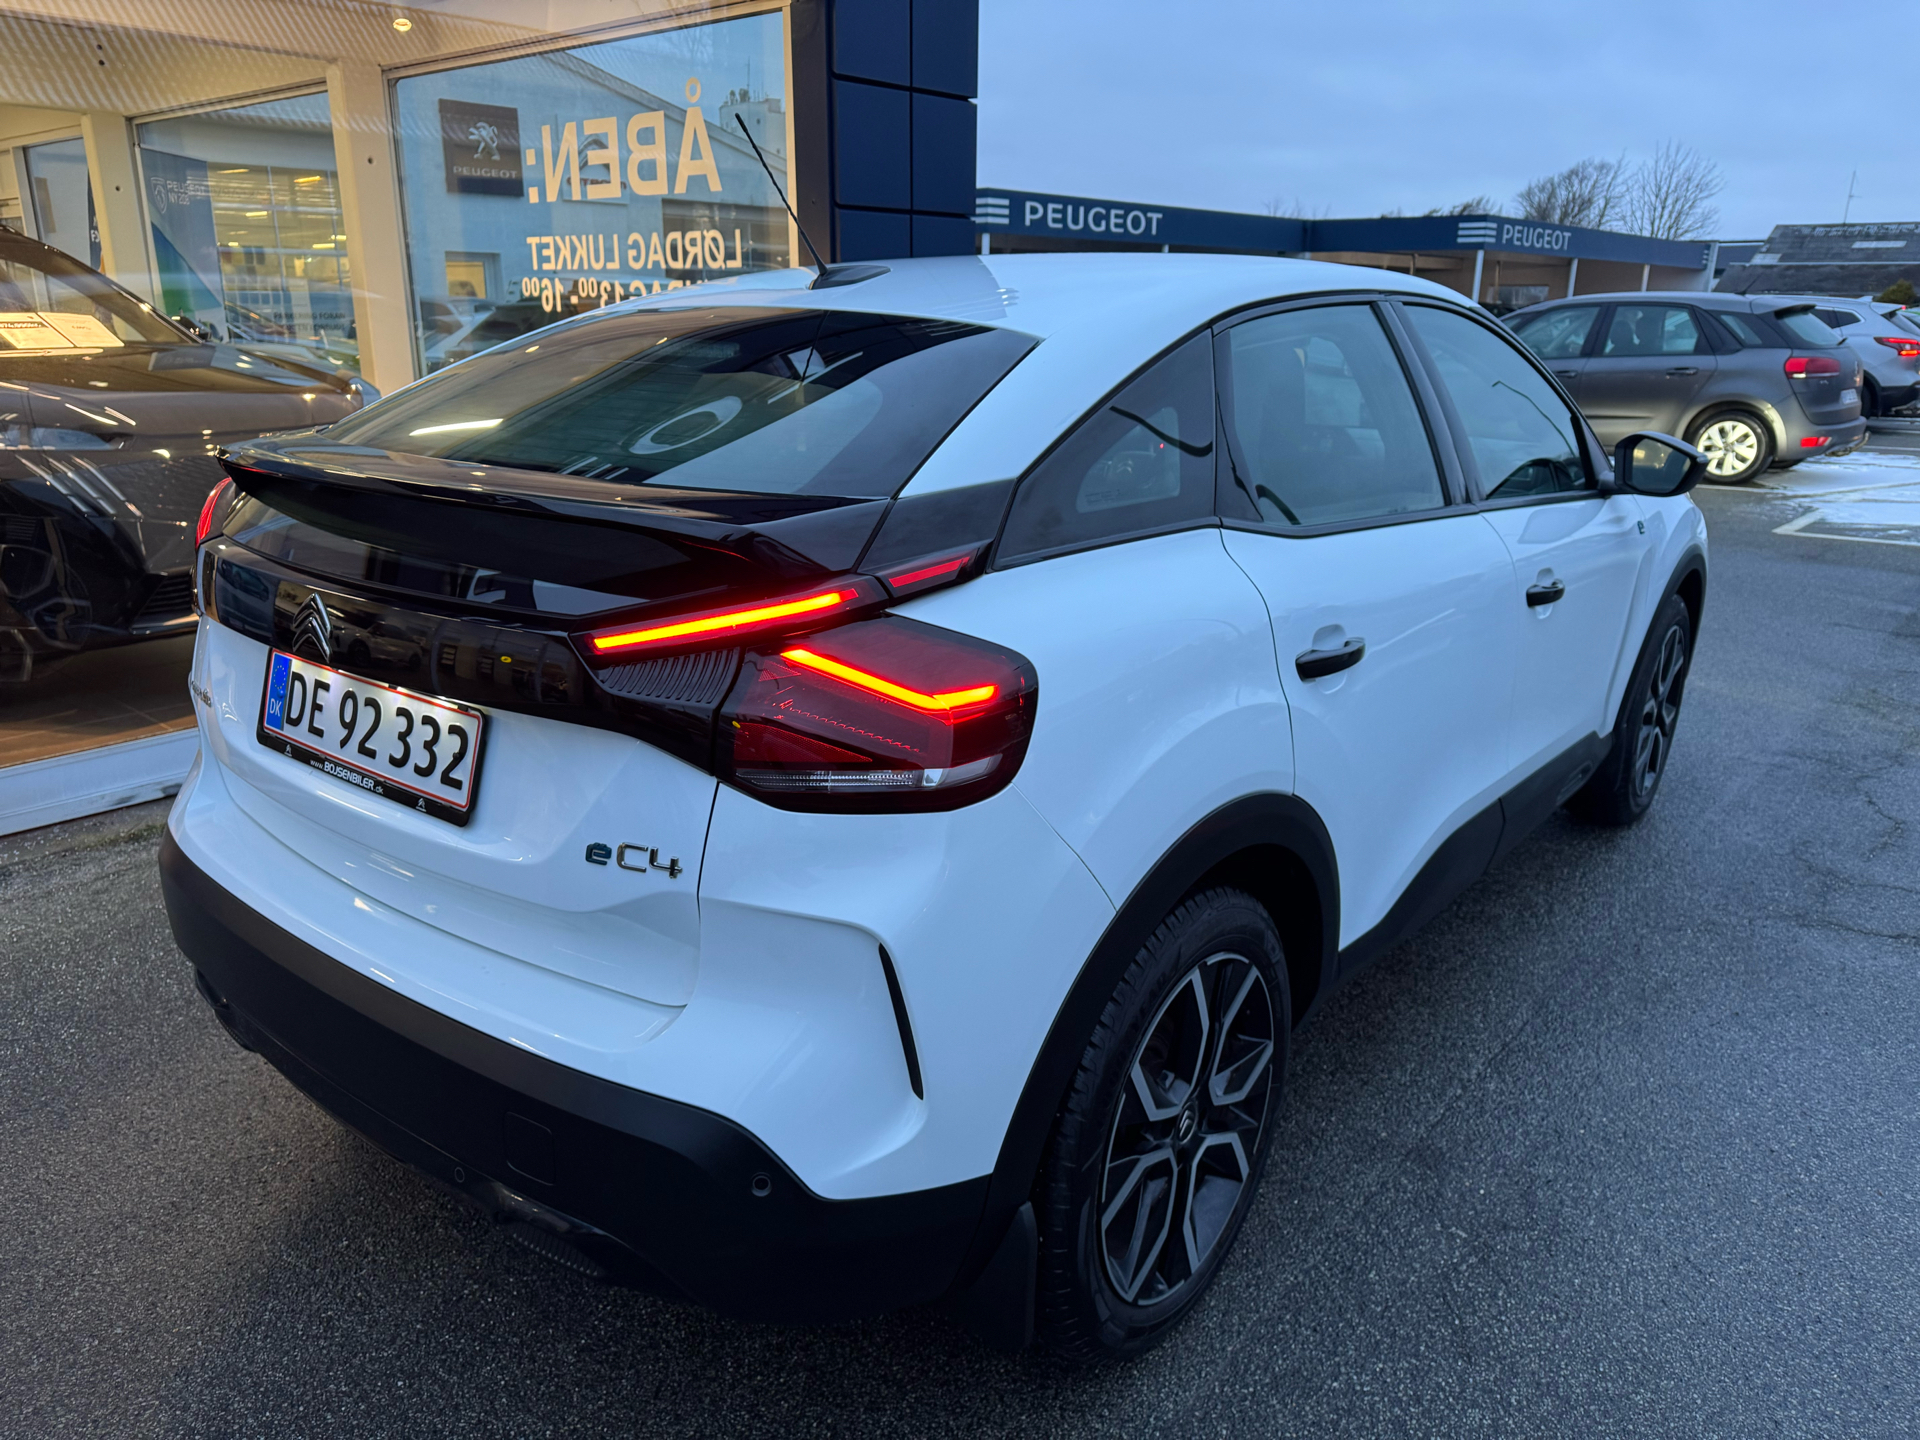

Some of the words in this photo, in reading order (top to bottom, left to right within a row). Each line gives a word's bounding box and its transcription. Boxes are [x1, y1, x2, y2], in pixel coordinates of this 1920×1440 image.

[453, 165, 518, 179] PEUGEOT
[1024, 200, 1163, 236] PEUGEOT
[1501, 223, 1572, 251] PEUGEOT
[269, 698, 282, 717] DK
[285, 671, 330, 738] DE
[339, 689, 382, 760] 92
[388, 706, 469, 791] 332
